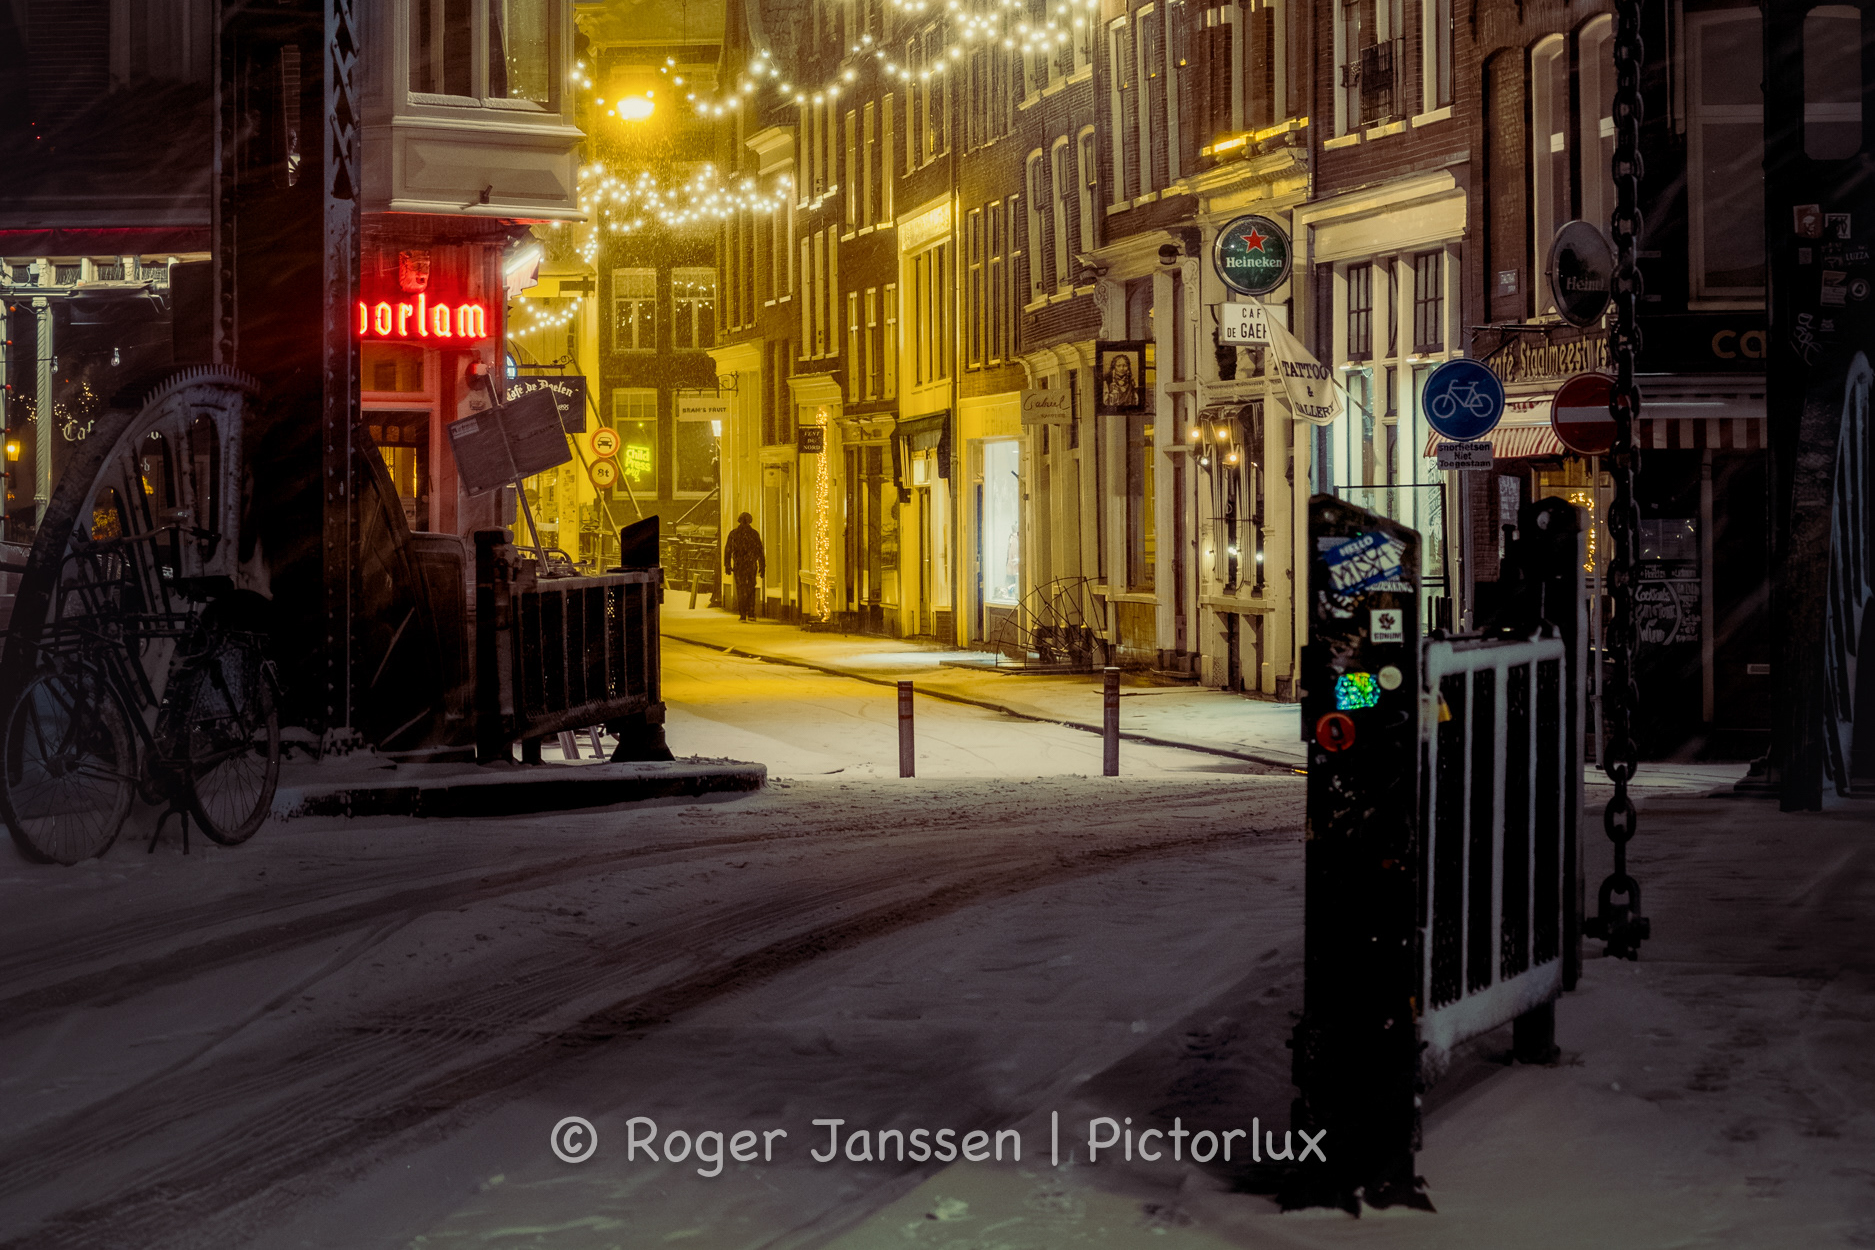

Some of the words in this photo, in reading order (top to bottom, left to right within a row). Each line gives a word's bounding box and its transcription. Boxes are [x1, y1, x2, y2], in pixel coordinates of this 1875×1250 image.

[1226, 255, 1283, 268] Heineken
[1242, 307, 1262, 319] CAF
[1227, 327, 1237, 338] DE
[1520, 335, 1608, 378] Staalmeestrs
[1281, 360, 1329, 381] TATTOO
[525, 381, 538, 394] de
[1306, 385, 1315, 398] &
[626, 448, 650, 462] Child
[1454, 452, 1472, 461] Niet
[625, 458, 652, 472] Press
[1440, 460, 1491, 468] Toegestaan
